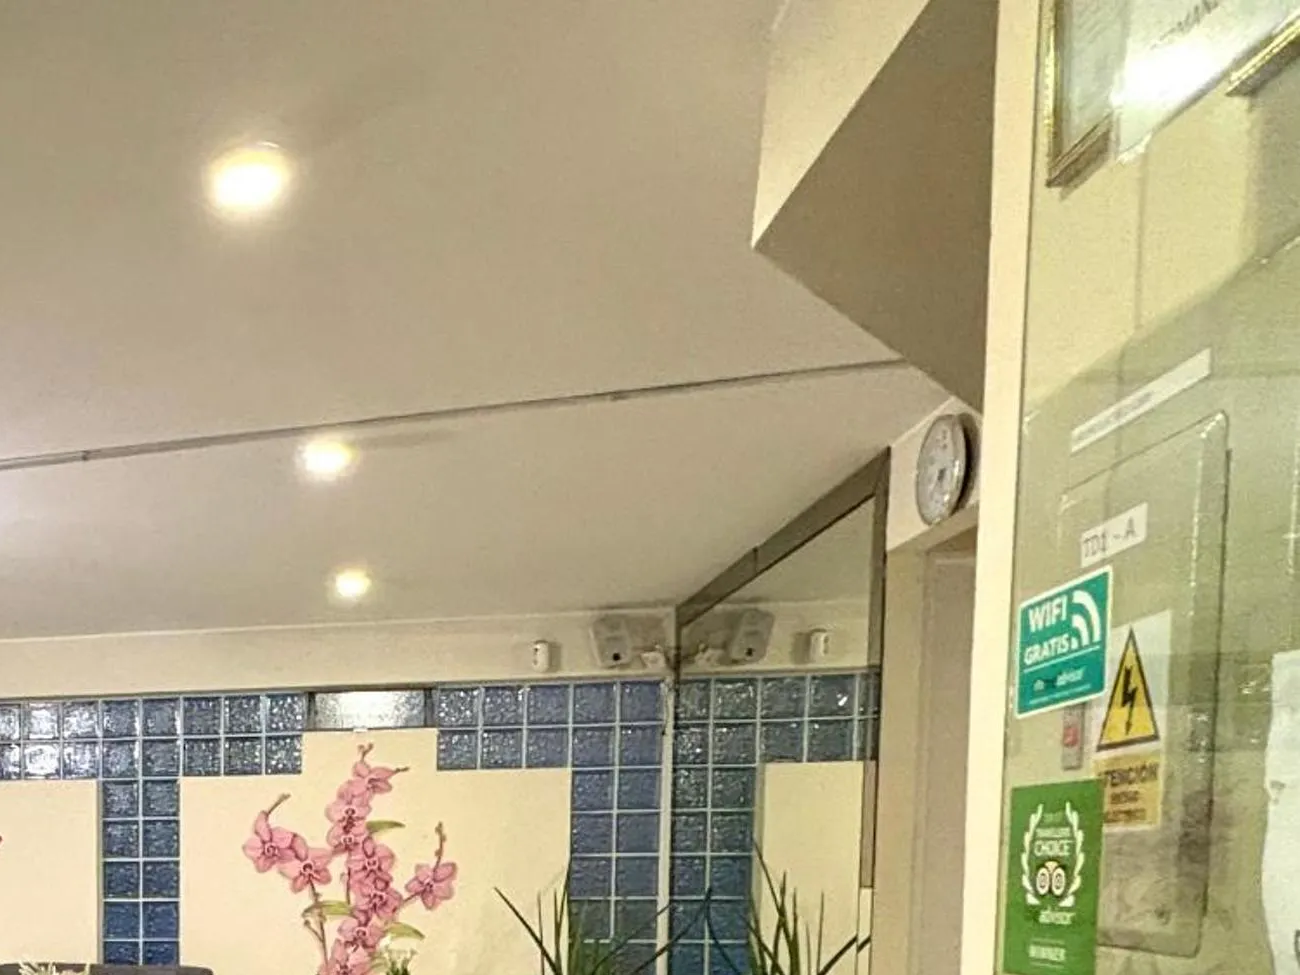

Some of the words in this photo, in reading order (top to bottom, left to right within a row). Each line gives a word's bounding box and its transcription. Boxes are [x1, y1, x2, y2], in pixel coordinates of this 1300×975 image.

[1123, 516, 1139, 540] A
[1028, 595, 1068, 632] WIFI
[1023, 634, 1071, 666] GRATIS
[1033, 840, 1074, 857] CHOICE
